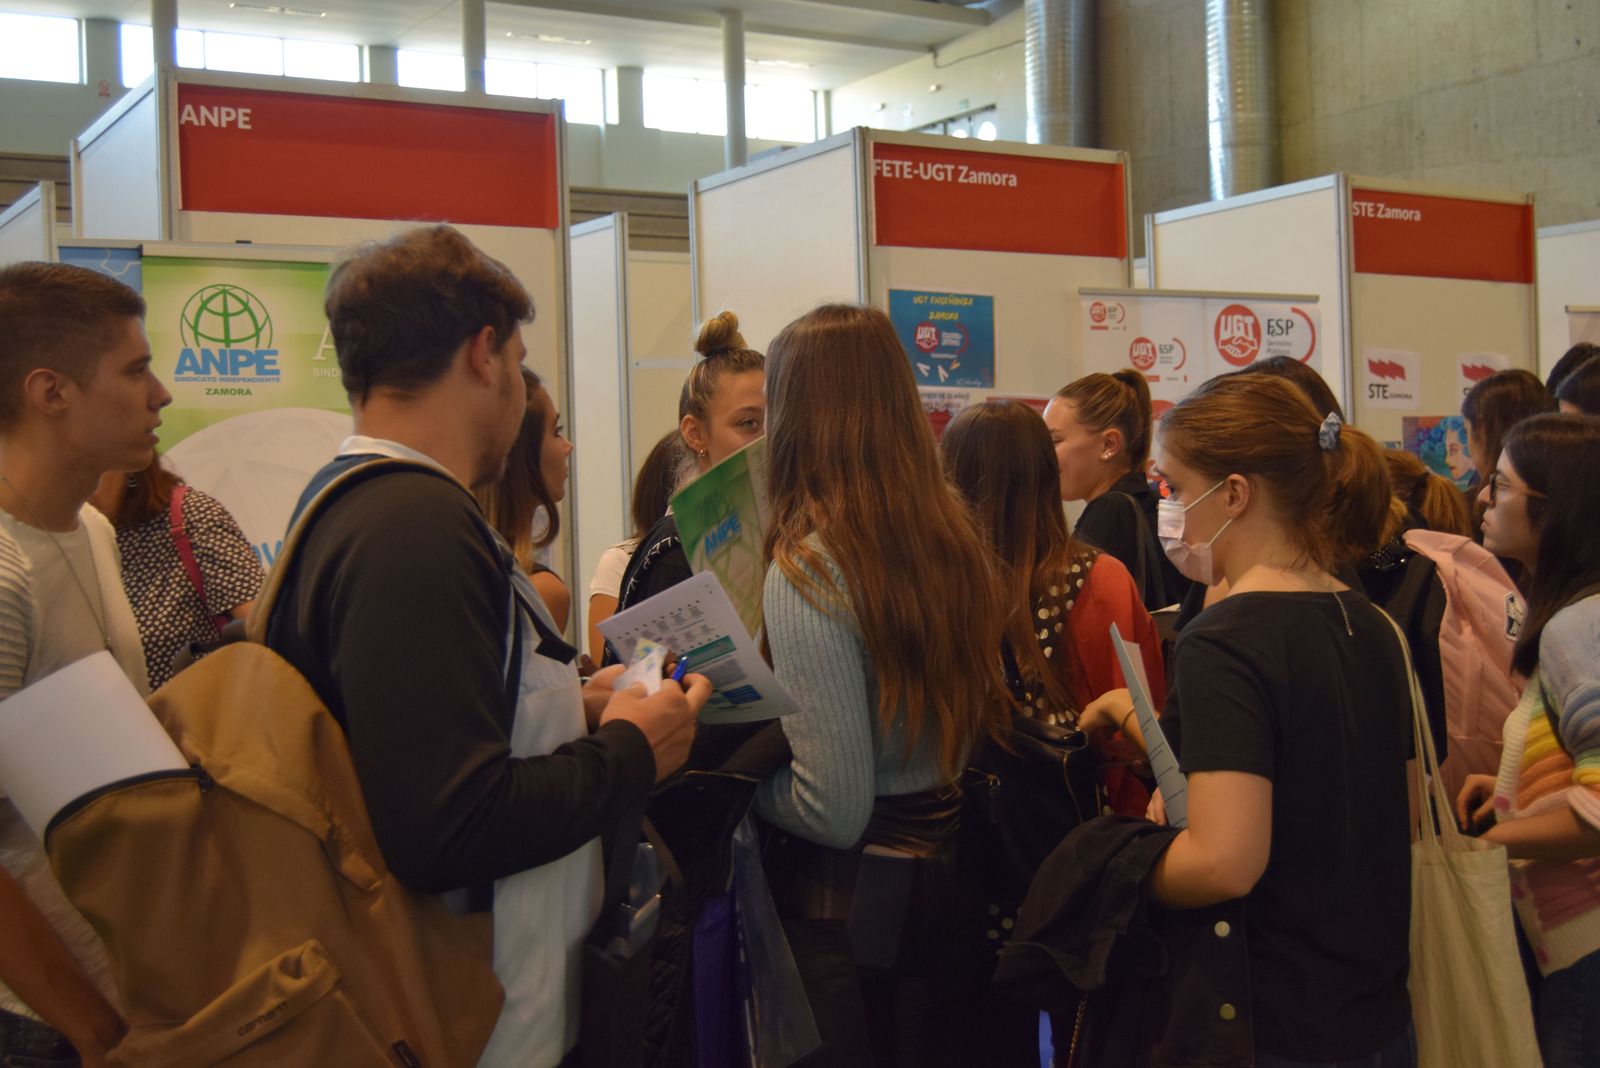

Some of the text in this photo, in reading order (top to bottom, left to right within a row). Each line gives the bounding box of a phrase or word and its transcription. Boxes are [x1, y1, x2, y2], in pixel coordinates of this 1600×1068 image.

[180, 104, 252, 130] ANPE
[873, 159, 1017, 187] FETE-UGT Zamora
[1352, 201, 1421, 221] STE Zamora
[1220, 314, 1255, 341] UGT
[174, 348, 280, 376] ANPE
[205, 387, 252, 396] ZAMORA
[1368, 383, 1389, 399] STE
